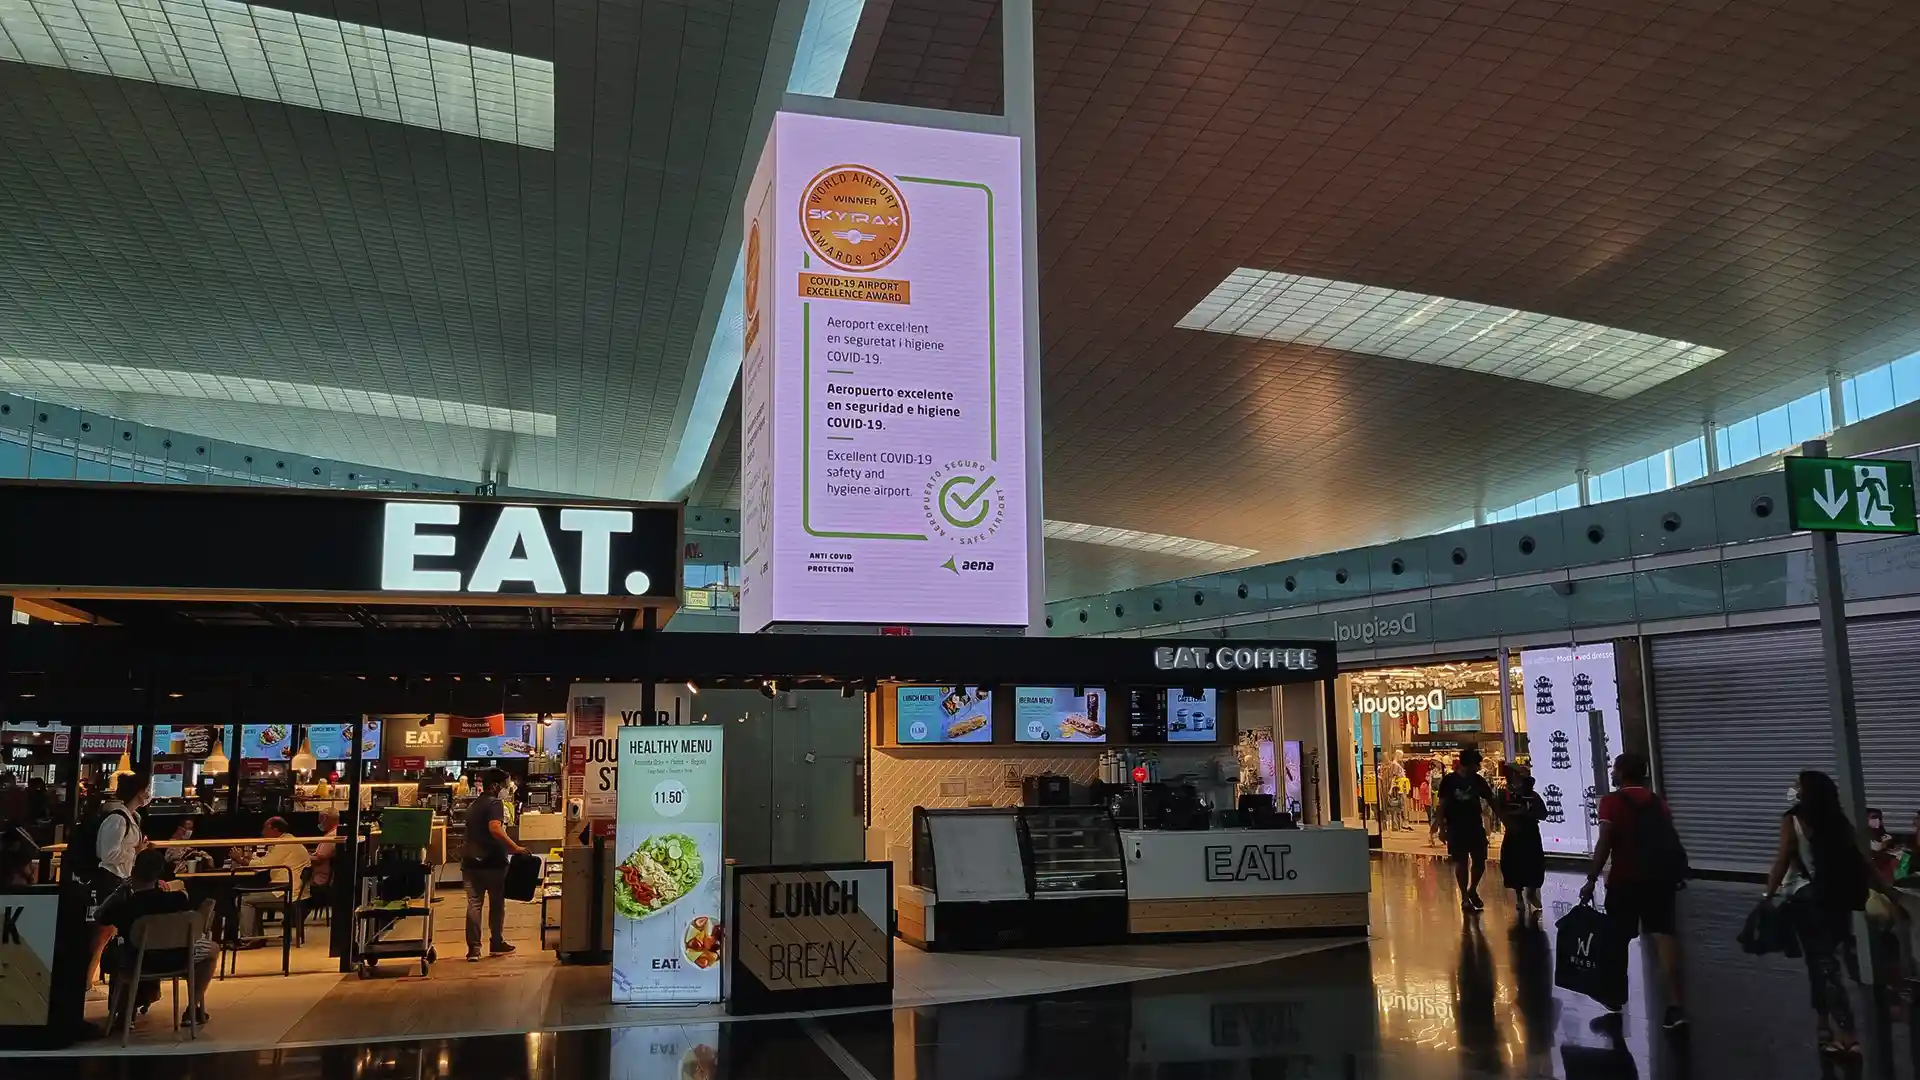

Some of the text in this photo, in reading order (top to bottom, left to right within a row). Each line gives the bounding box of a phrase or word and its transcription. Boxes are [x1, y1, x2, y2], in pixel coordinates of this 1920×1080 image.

[811, 173, 899, 209] WORLD AIRPORT
[833, 195, 877, 206] WINNER
[808, 208, 900, 227] SKYTRAX
[811, 228, 898, 265] AWARDS 2021
[810, 276, 899, 291] COVID-19 AIRPORT
[806, 287, 902, 301] EXCELLENCE AWARD
[827, 316, 875, 330] Aeroport
[827, 335, 841, 344] en
[844, 336, 895, 348] seguretat
[905, 339, 944, 351] higiene
[827, 351, 882, 364] COVID-19.
[827, 383, 953, 400] Aeropuerto excelente
[827, 402, 841, 410] en
[845, 402, 903, 414] seguridad
[917, 406, 960, 418] higiene
[827, 417, 886, 430] COVID-19.
[827, 450, 932, 465] Excellent COVID-19
[827, 467, 885, 480] safety and
[827, 483, 913, 497] hygiene airport.
[923, 460, 985, 537] AEROPUERTO SEGURO
[960, 487, 1005, 545] SAFE AIRPORT
[381, 502, 651, 595] EAT.
[809, 552, 828, 560] ANTI
[807, 565, 854, 573] PROTECTION
[962, 560, 994, 571] aena
[1556, 655, 1573, 663] Most
[1591, 651, 1614, 659] dresse
[82, 738, 105, 748] RGER
[405, 730, 444, 744] EAT.
[586, 738, 618, 763] JOU
[629, 739, 712, 754] HEALTHY MENU
[1205, 845, 1297, 882] EAT.
[770, 880, 859, 918] LUNCH
[2, 906, 25, 944] K
[652, 958, 681, 970] EAT.
[770, 940, 858, 980] BREAK
